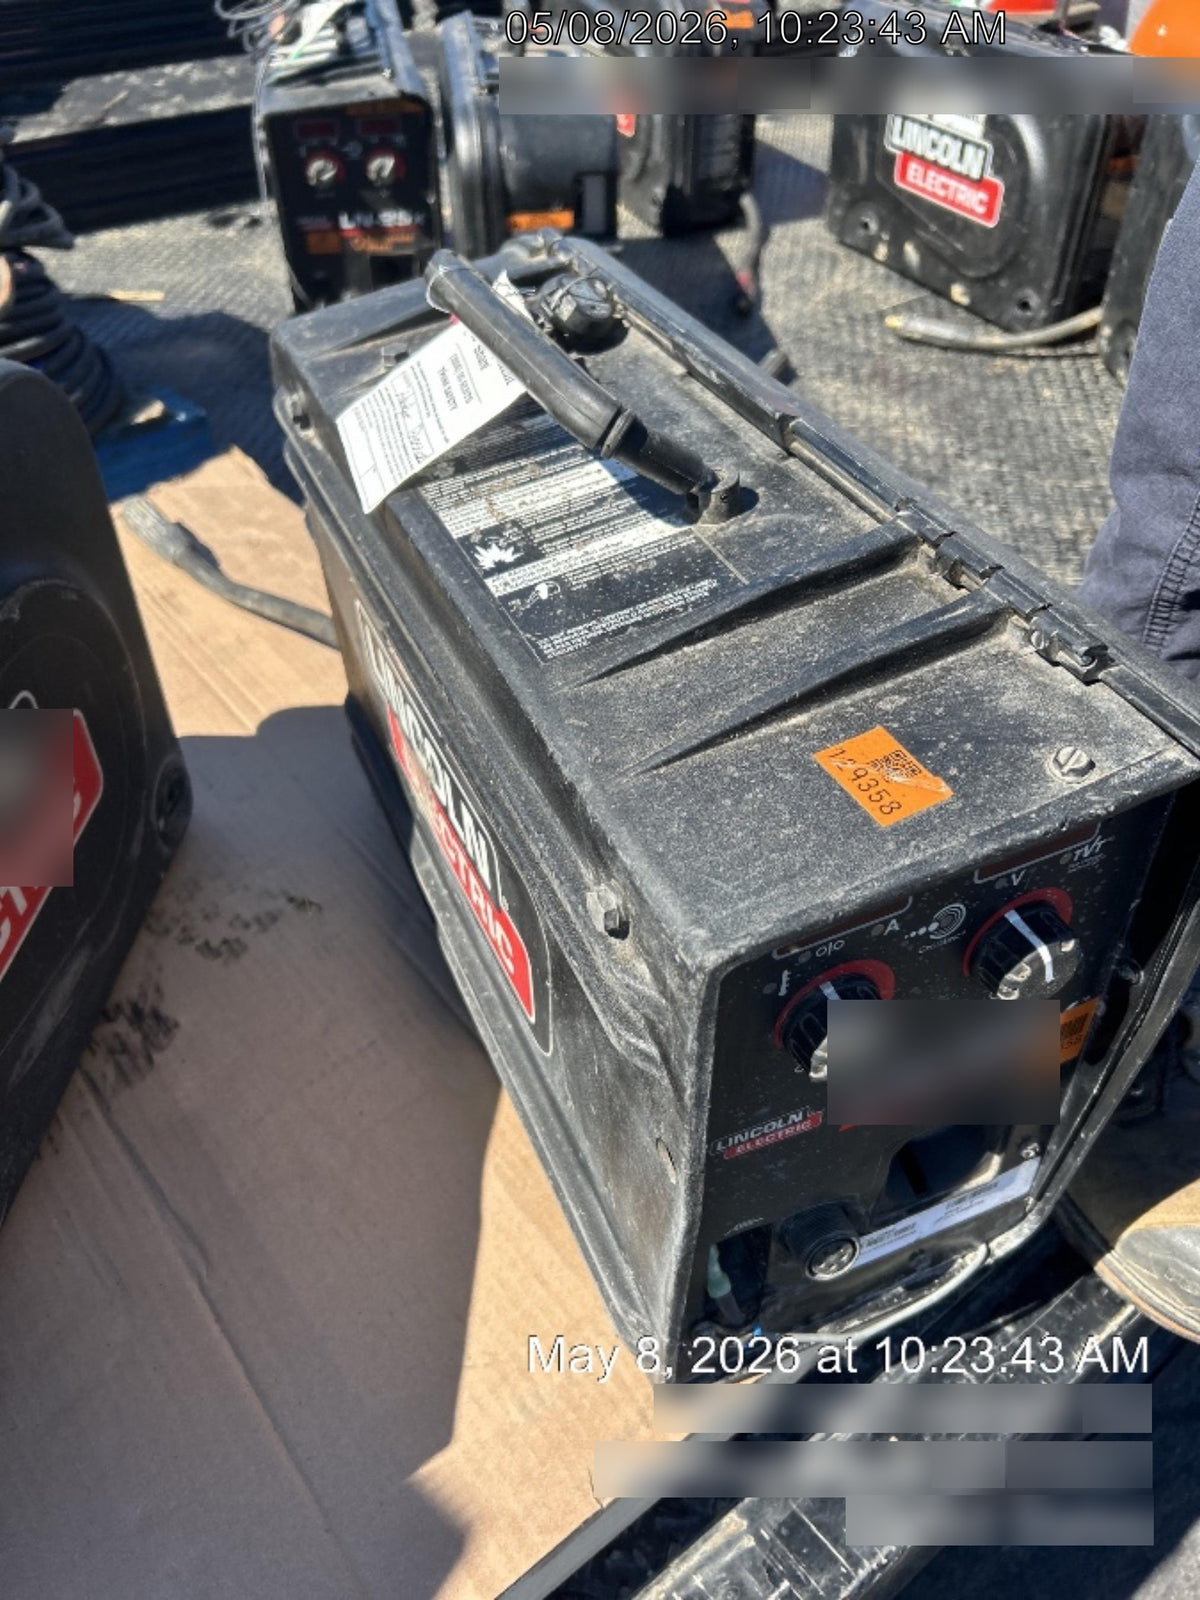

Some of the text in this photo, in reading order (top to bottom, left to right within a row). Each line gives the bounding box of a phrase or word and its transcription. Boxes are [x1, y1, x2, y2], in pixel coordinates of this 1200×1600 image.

[891, 114, 986, 181] LINCOLN
[906, 160, 989, 214] ELECTRIC
[363, 624, 492, 891] LINCOLN
[1011, 869, 1026, 886] V
[883, 918, 900, 936] A
[715, 1110, 804, 1152] LINCOLN
